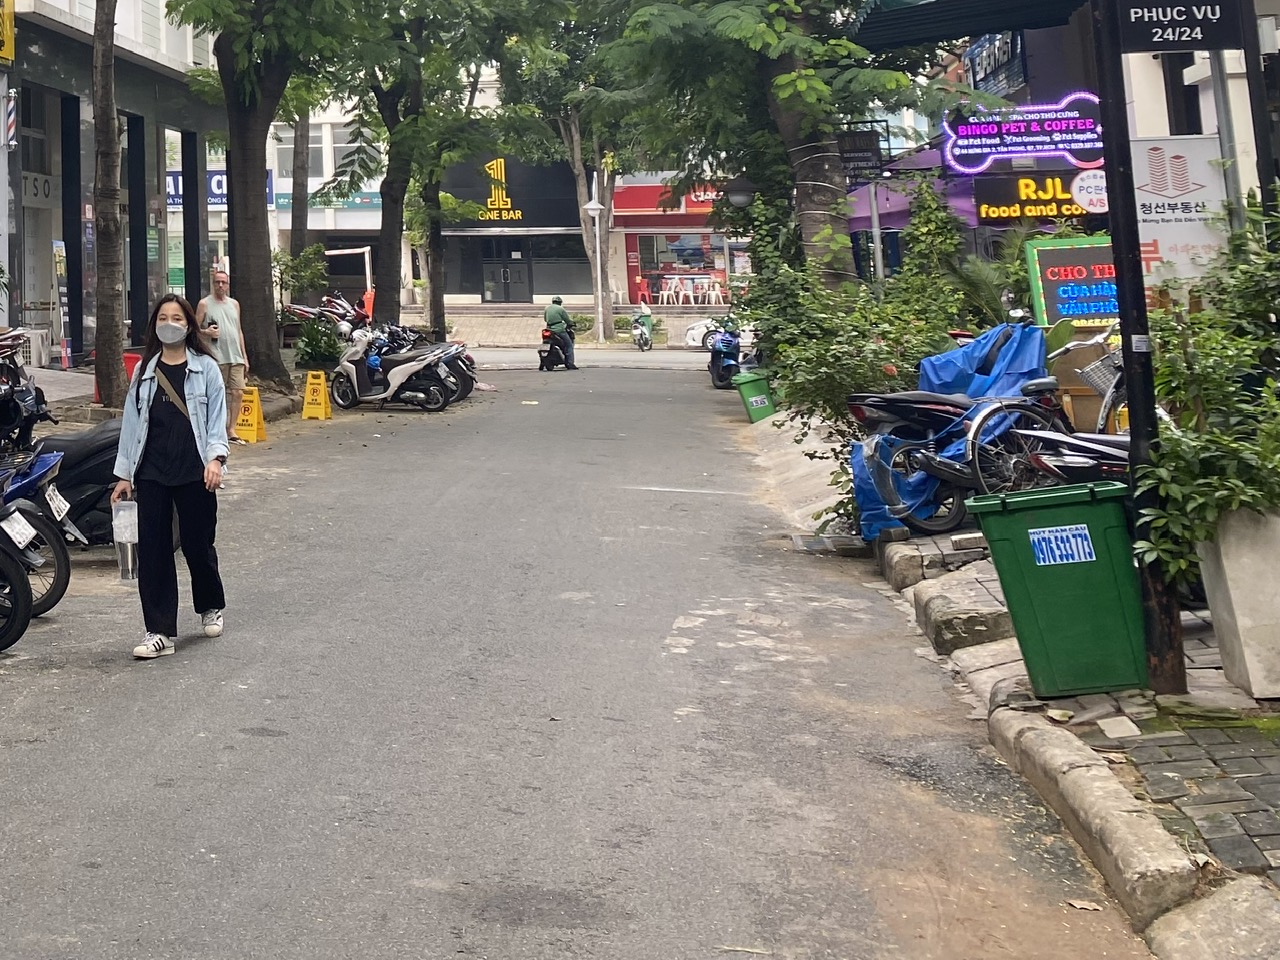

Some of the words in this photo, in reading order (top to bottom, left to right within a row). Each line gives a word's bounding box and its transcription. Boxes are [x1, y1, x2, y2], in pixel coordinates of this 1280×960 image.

[1130, 6, 1187, 24] PHỤC
[1192, 5, 1221, 22] VỤ
[1152, 27, 1203, 41] 24/24
[958, 124, 998, 136] BINGO
[1001, 122, 1027, 133] PET
[1030, 121, 1041, 132] &
[1044, 119, 1094, 131] COFFEE
[1018, 177, 1071, 200] RJL
[1079, 185, 1107, 195] PC판
[980, 204, 1021, 218] food
[1024, 202, 1058, 216] and
[1088, 198, 1107, 208] A/S
[478, 210, 500, 220] ONE
[502, 210, 522, 220] BAR
[1046, 266, 1087, 280] CHO
